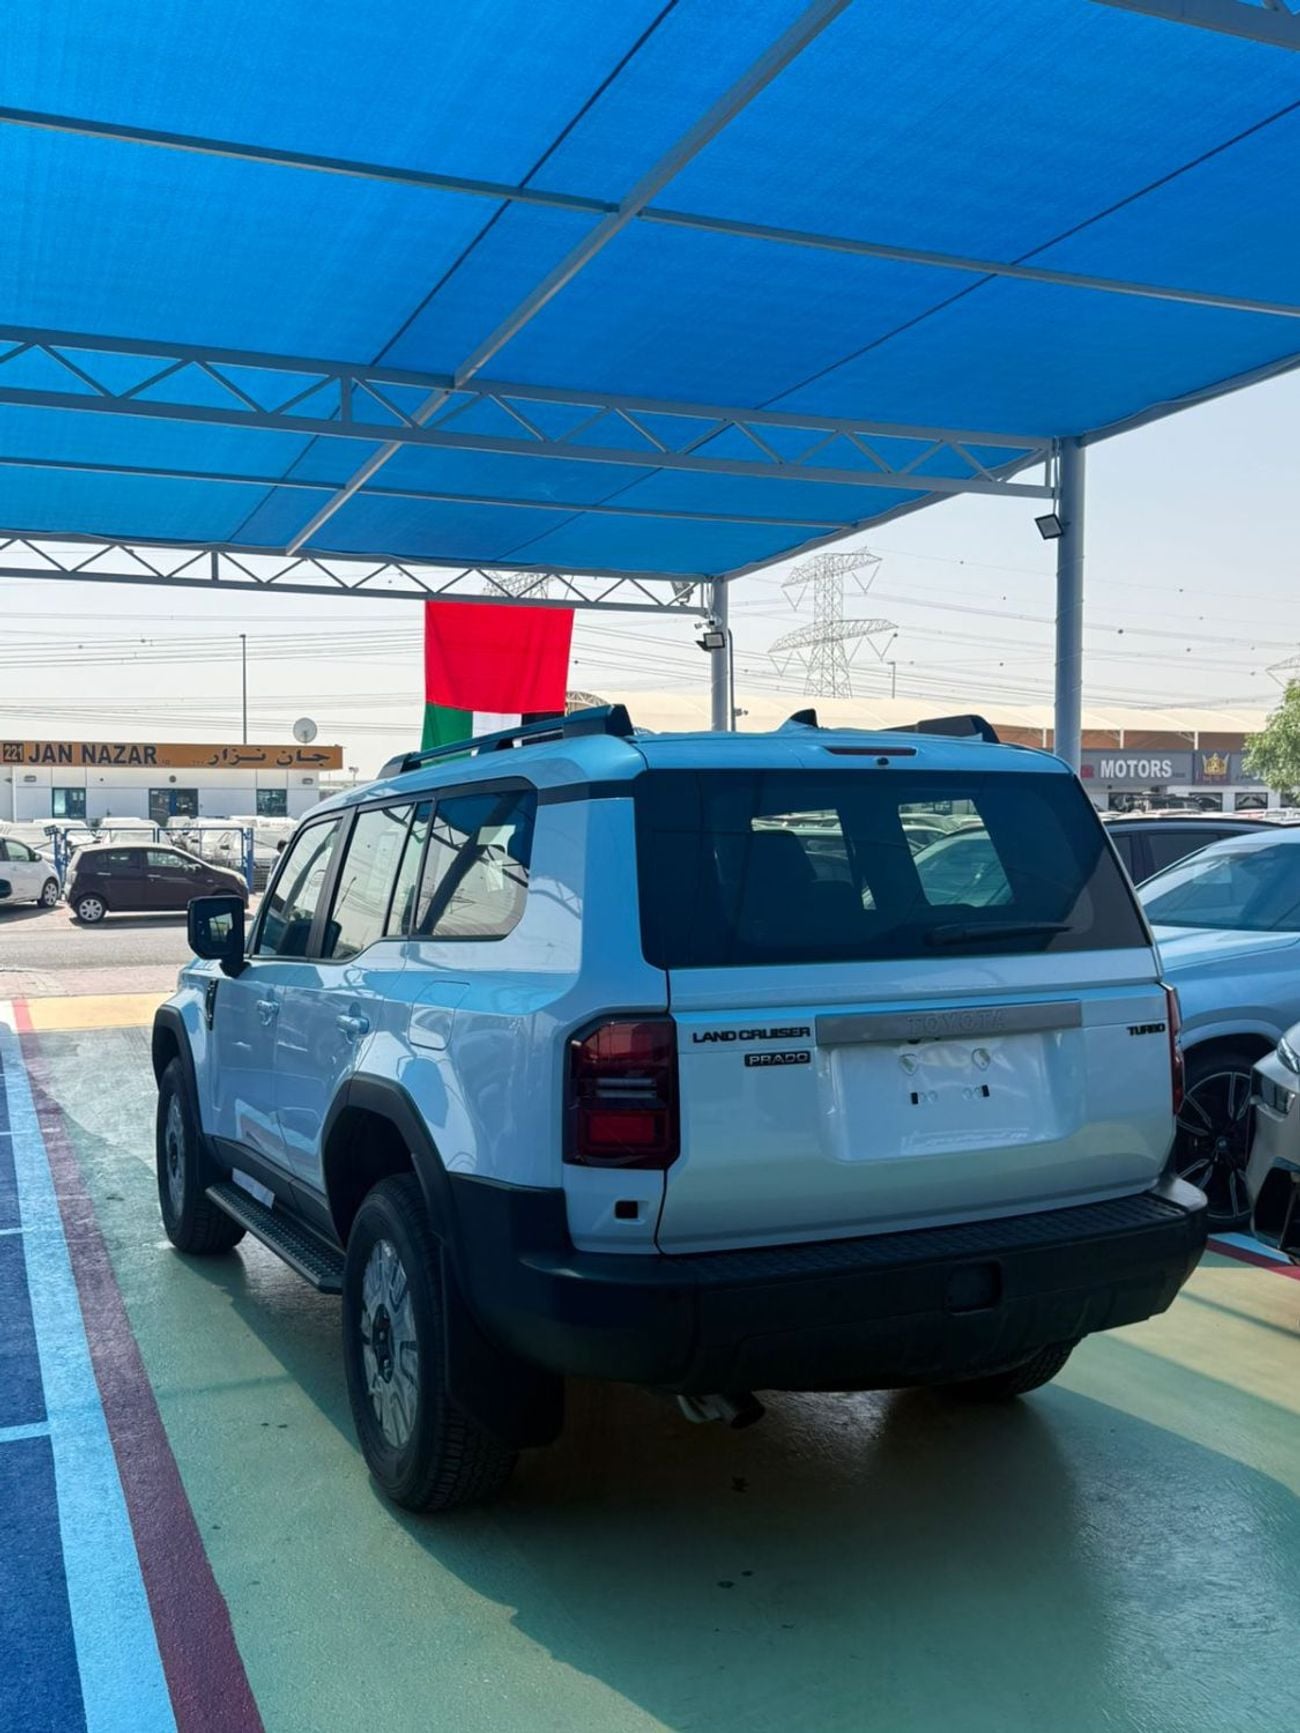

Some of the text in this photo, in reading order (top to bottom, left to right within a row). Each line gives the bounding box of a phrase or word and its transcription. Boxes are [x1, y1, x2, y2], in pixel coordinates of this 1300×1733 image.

[4, 743, 156, 764] 221 JAN NAZAR
[276, 749, 330, 766] جان
[1100, 759, 1172, 778] MOTORS
[907, 1009, 1005, 1034] TOYOTA
[1126, 1022, 1166, 1036] TURBO
[692, 1026, 811, 1044] LAND CRUISER
[748, 1052, 809, 1066] PRADO
